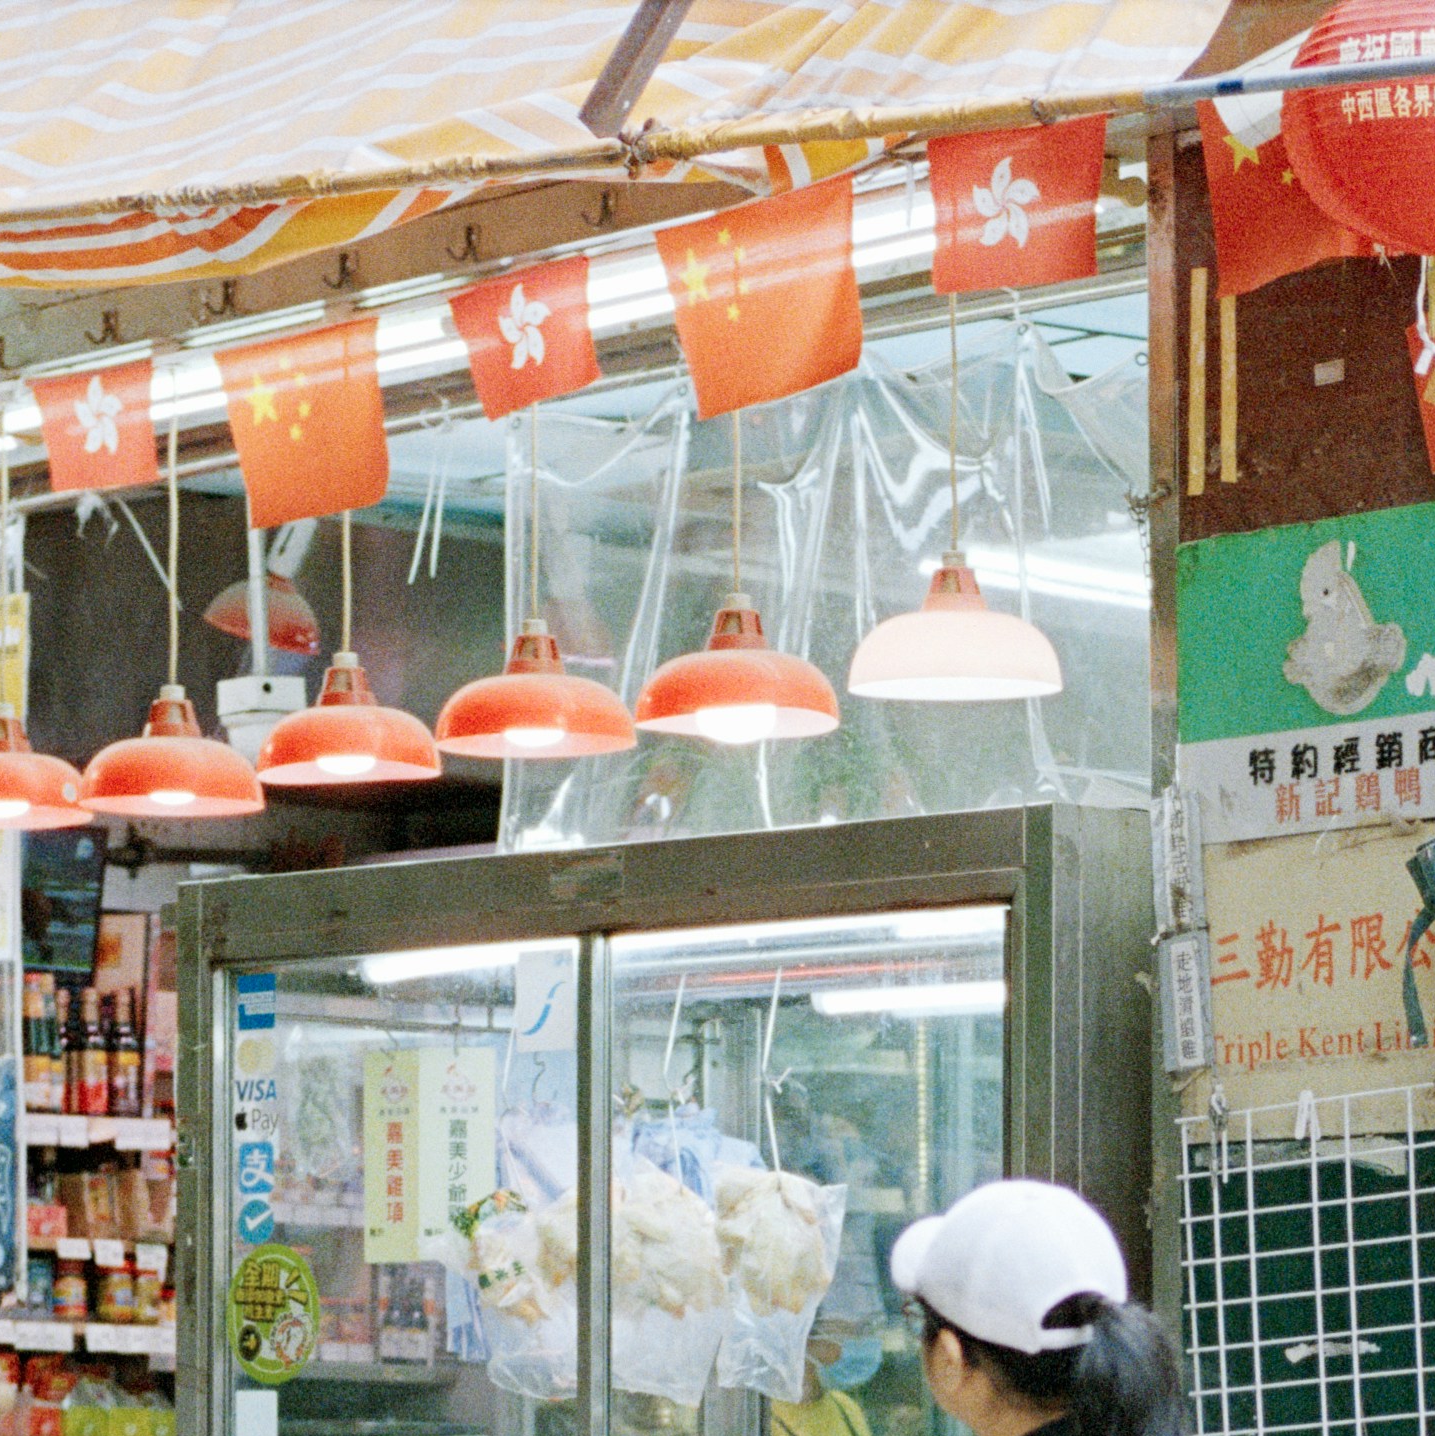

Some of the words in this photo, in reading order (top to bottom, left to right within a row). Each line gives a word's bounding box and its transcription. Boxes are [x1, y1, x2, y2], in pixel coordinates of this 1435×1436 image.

[1299, 1023, 1365, 1061] Kent
[234, 1079, 277, 1102] VISA
[251, 1108, 279, 1136] Pay
